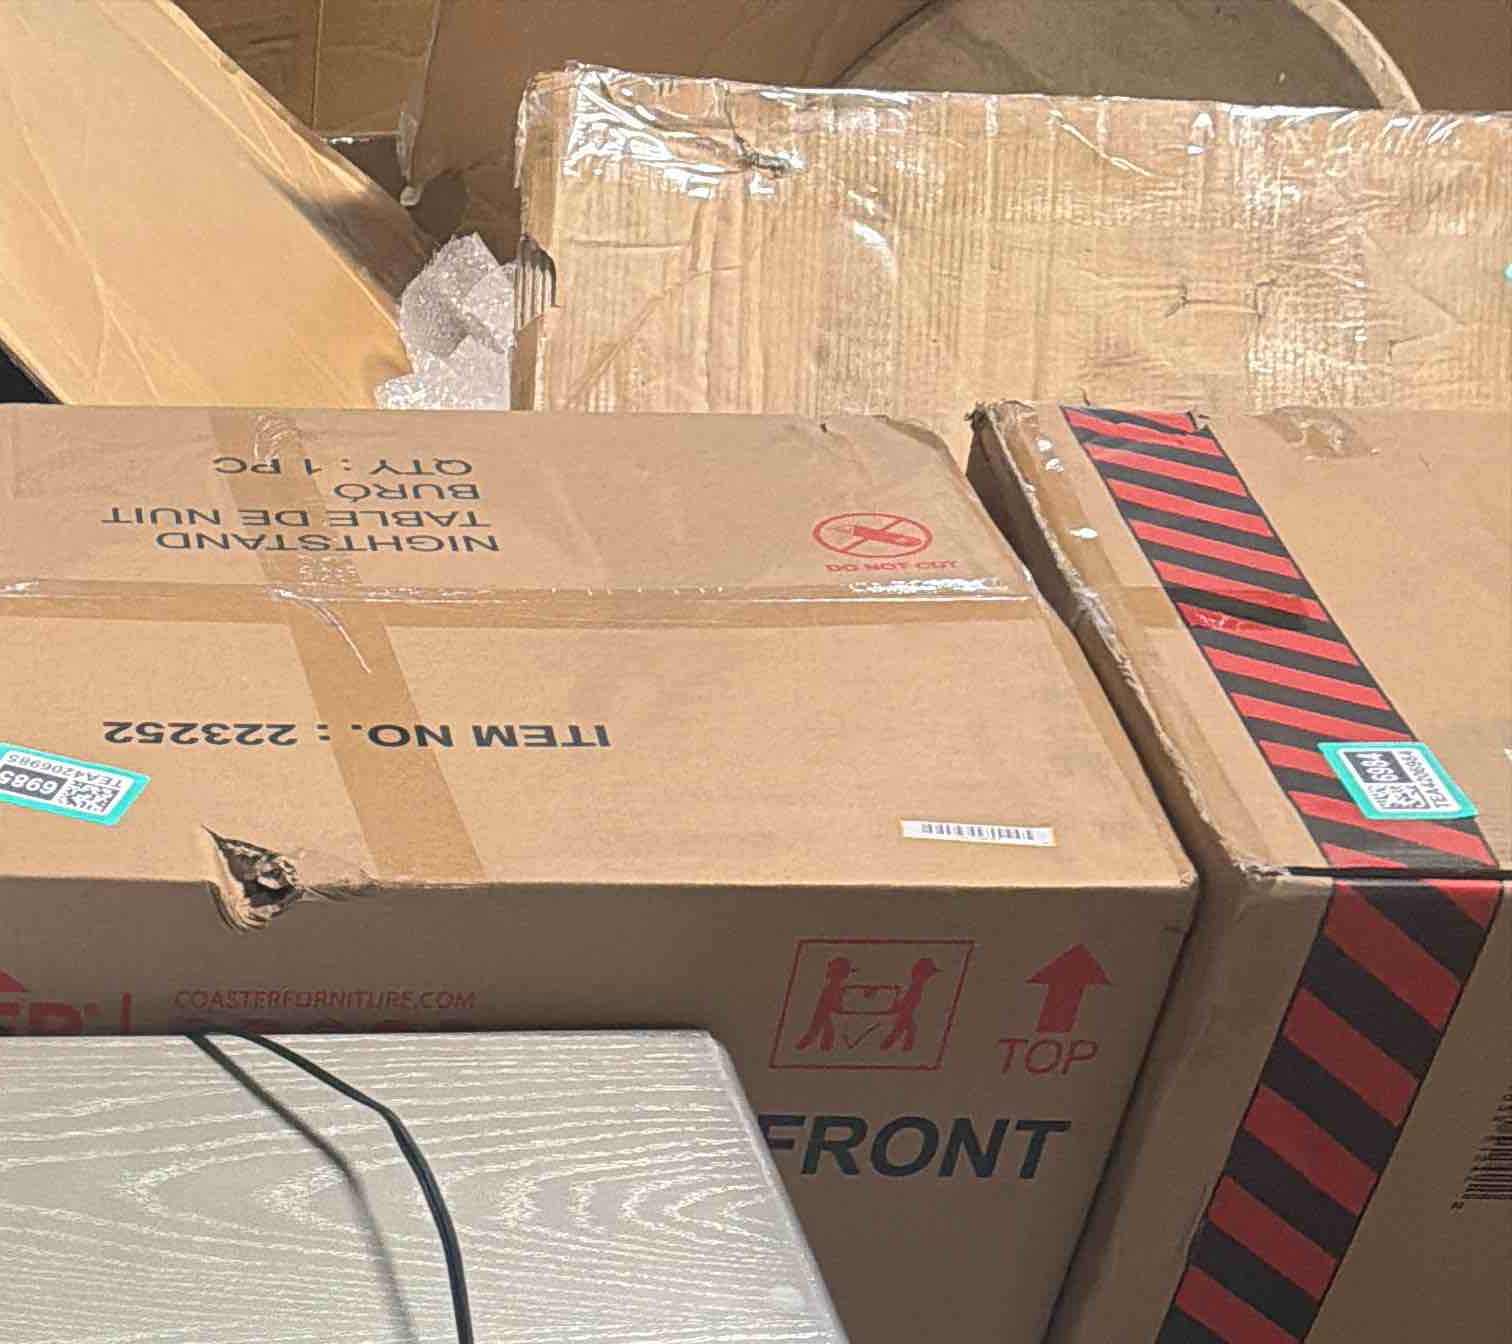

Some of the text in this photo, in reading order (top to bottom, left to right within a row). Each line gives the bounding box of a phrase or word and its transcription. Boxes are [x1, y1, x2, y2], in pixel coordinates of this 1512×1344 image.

[212, 456, 281, 476] PC
[304, 457, 322, 476] 1
[370, 457, 473, 476] QTY
[334, 483, 481, 502] BURÓ
[101, 506, 491, 528] TABLE DE NUIT
[156, 531, 500, 553] NIGHTSTAND
[824, 560, 960, 572] DO NOT CUT
[102, 720, 298, 745] 223252
[351, 722, 454, 748] NO.
[470, 723, 612, 748] ITEM
[8, 754, 124, 788] TEA4206985
[1353, 752, 1400, 783] 6984
[998, 1038, 1099, 1075] TOP
[758, 1114, 1073, 1180] FRONT
